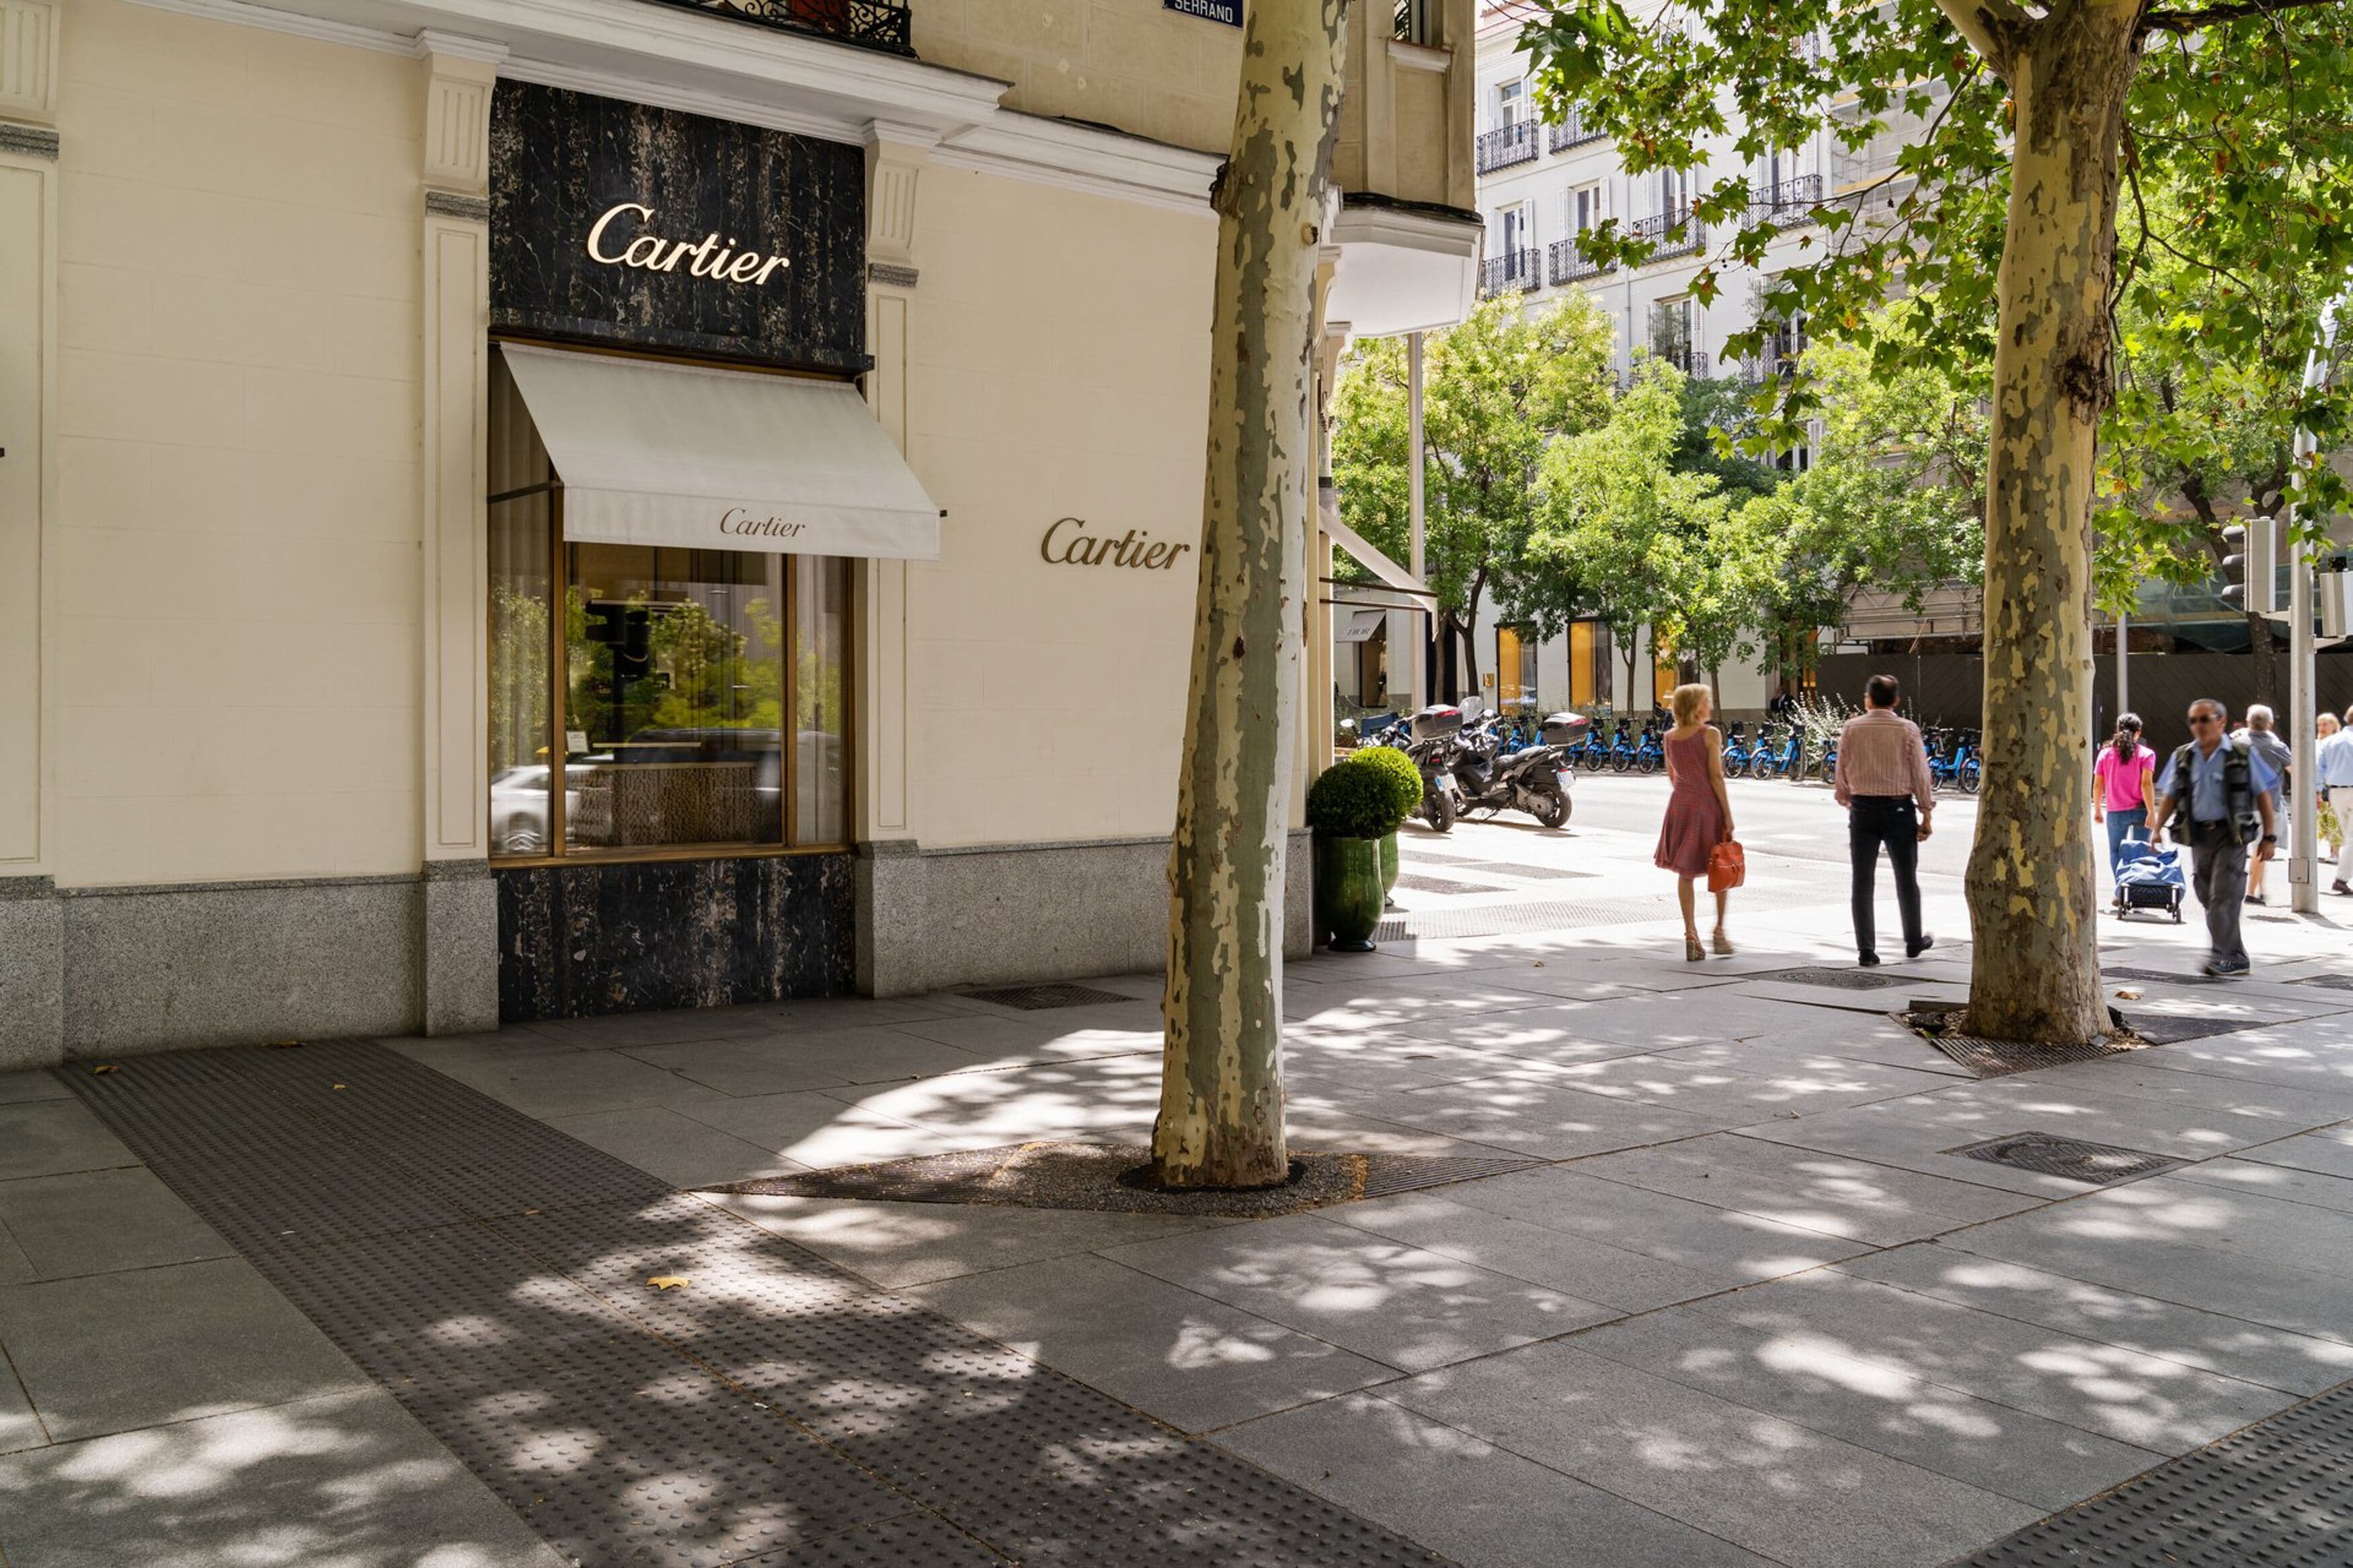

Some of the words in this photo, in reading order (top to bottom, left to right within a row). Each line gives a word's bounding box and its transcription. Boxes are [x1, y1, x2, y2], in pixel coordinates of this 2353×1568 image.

[1174, 0, 1232, 23] SERRANO
[587, 204, 790, 285] Cartier
[720, 508, 805, 537] Cartier
[1041, 518, 1191, 570] Cartier
